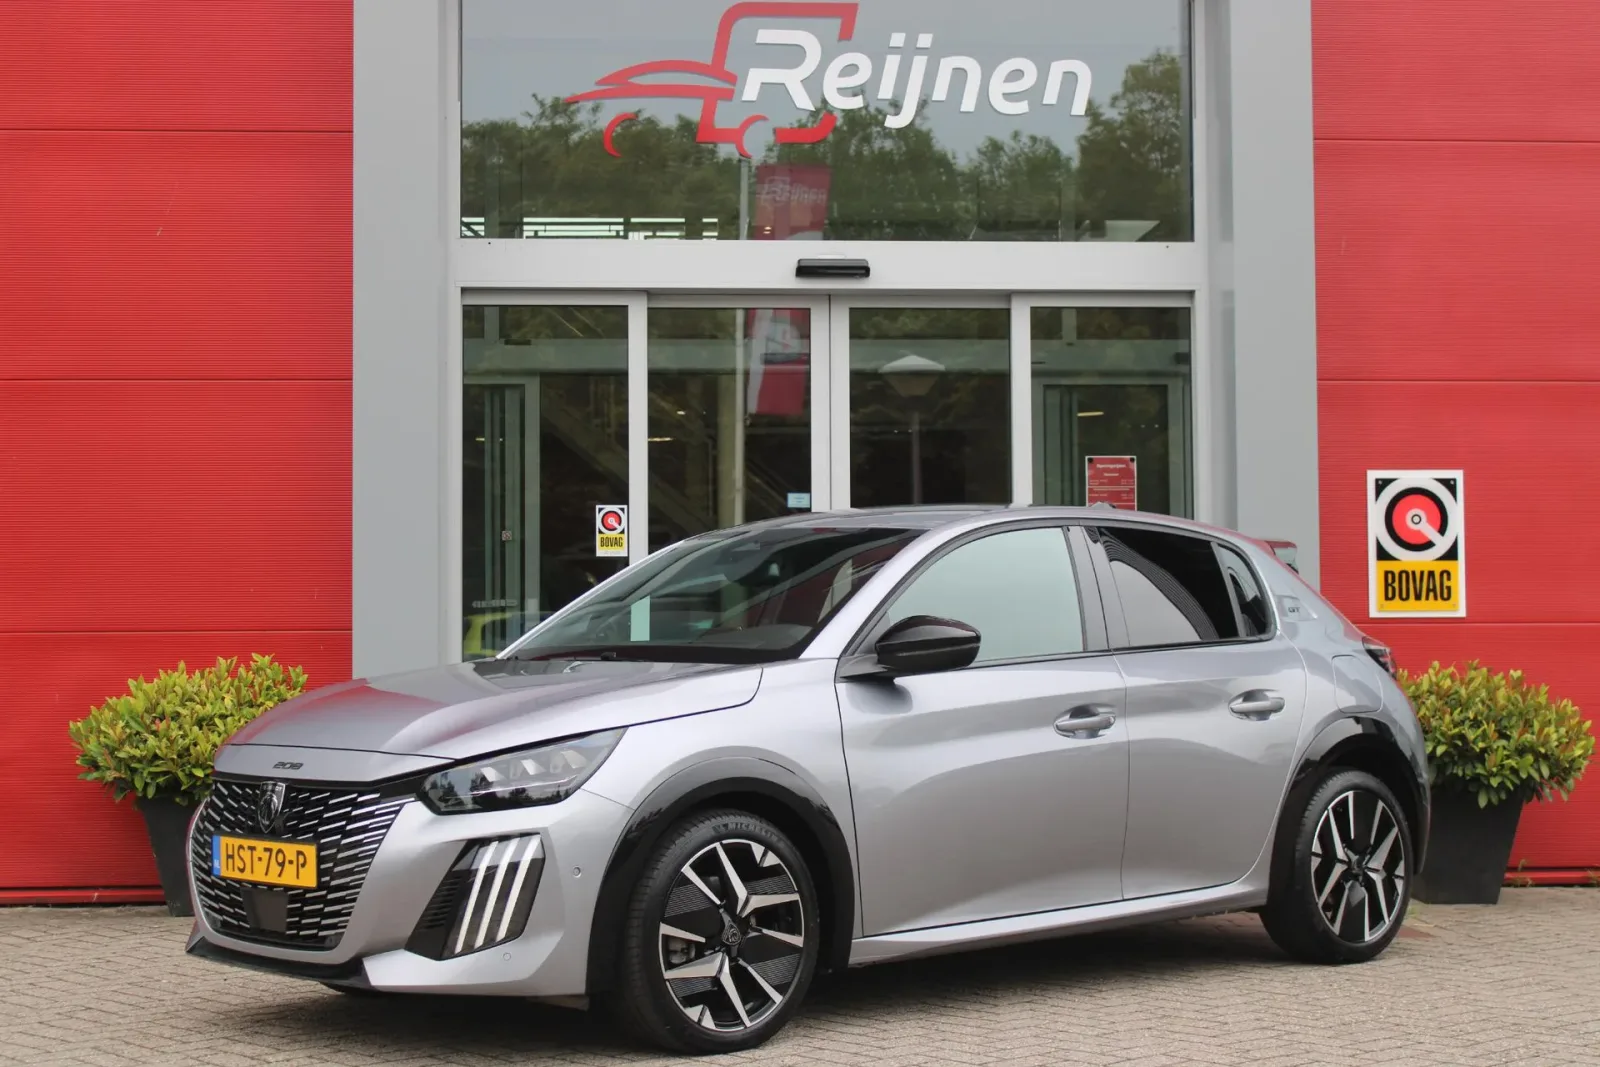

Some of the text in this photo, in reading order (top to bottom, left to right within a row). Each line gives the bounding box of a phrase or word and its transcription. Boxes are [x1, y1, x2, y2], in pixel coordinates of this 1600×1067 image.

[741, 28, 1093, 129] Reijnen
[600, 536, 624, 548] BOVAG
[1383, 569, 1452, 602] BOVAG
[272, 761, 304, 770] 208
[727, 821, 779, 842] MICHELIN
[225, 842, 307, 880] HST-79-P
